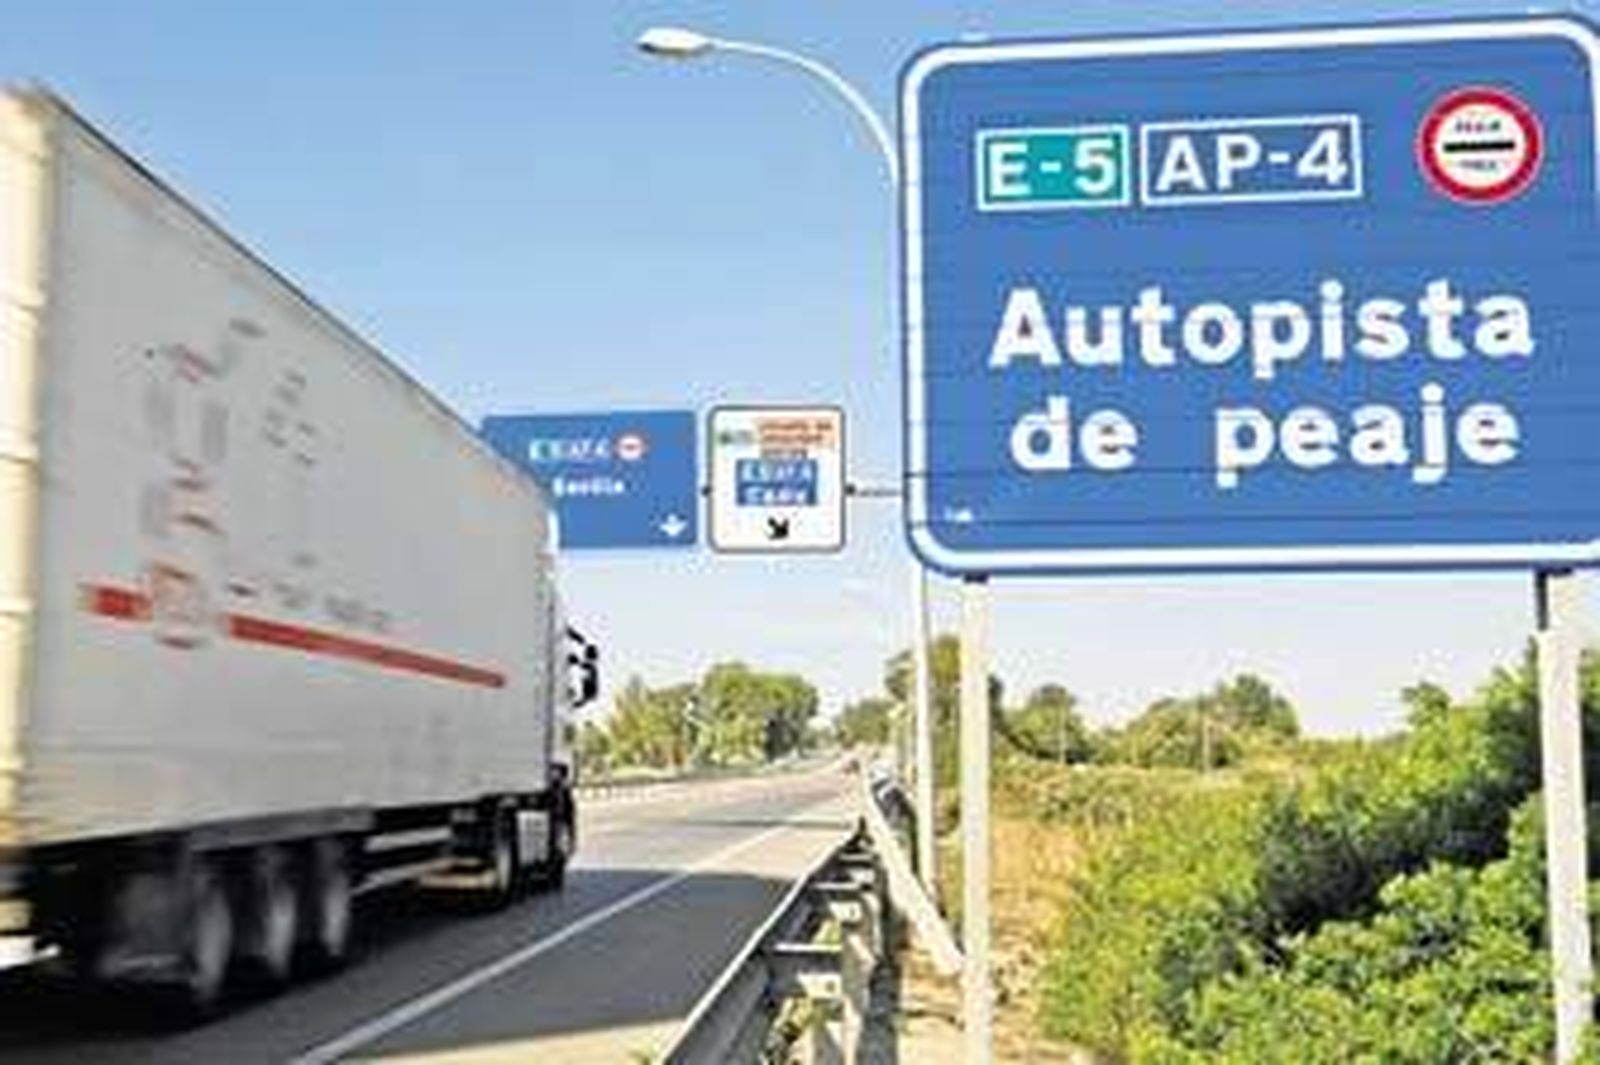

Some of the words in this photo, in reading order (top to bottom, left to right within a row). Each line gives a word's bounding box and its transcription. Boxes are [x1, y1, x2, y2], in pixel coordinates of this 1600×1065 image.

[988, 139, 1117, 196] E-5
[1155, 128, 1349, 192] AP-4
[988, 279, 1534, 379] Autopista
[1010, 396, 1138, 470] de
[1216, 383, 1519, 488] peaje
